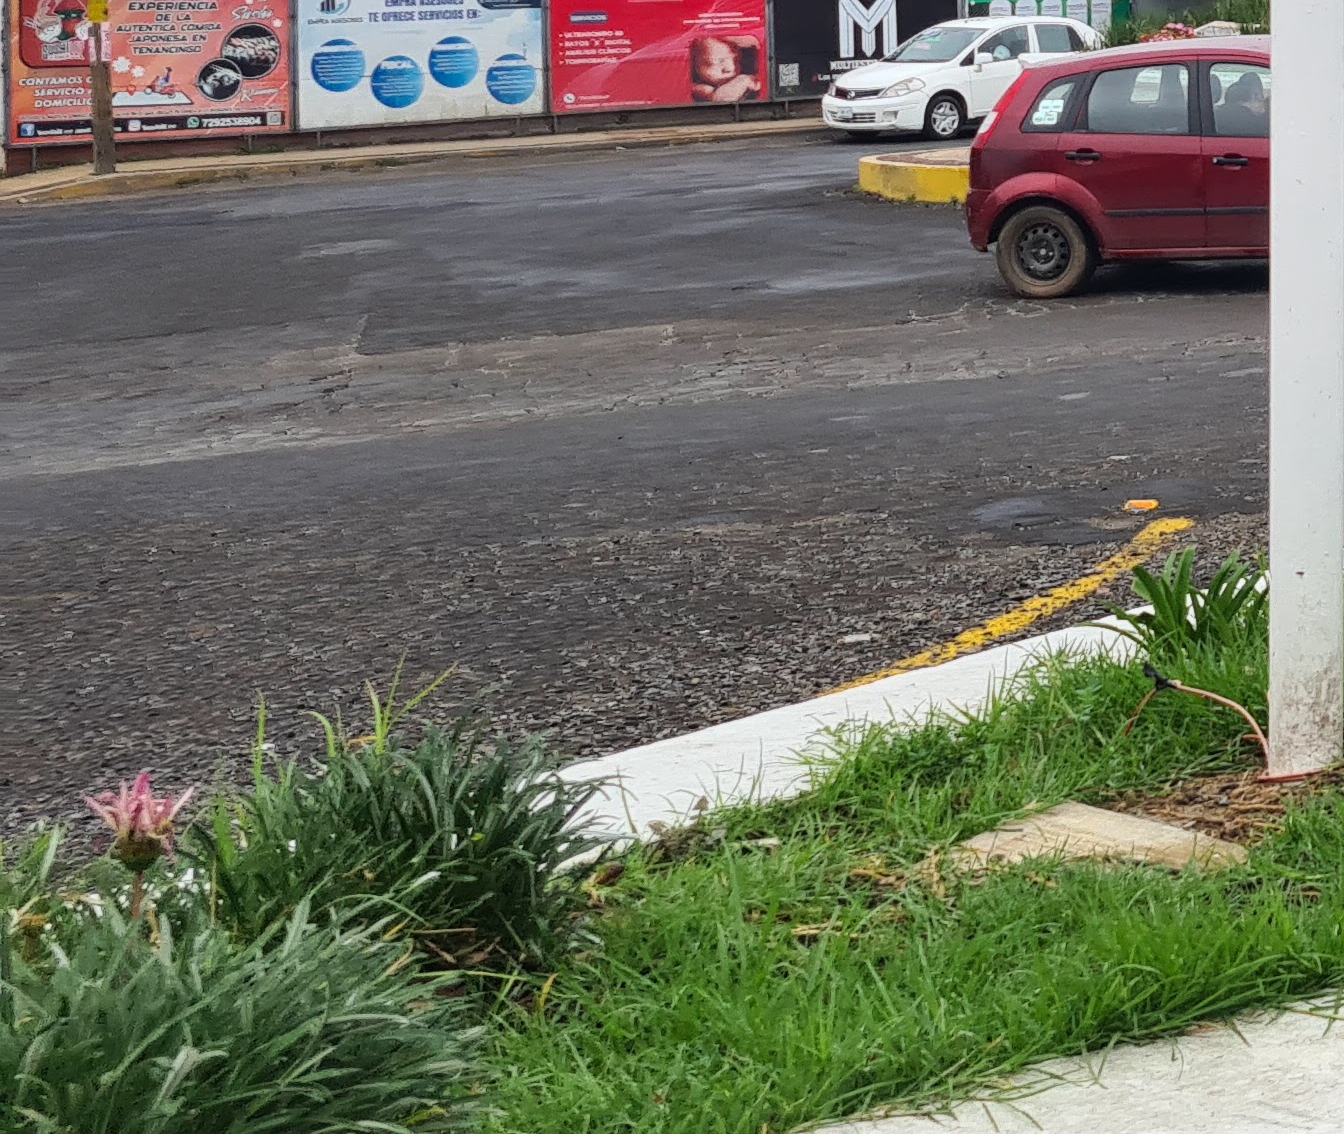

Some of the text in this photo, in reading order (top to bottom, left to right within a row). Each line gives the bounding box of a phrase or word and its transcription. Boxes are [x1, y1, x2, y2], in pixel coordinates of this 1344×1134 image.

[128, 1, 218, 11] EXPERIENCIA
[155, 13, 191, 22] DE LA
[19, 76, 83, 86] CONTAMOS
[34, 87, 84, 97] SERVICIO
